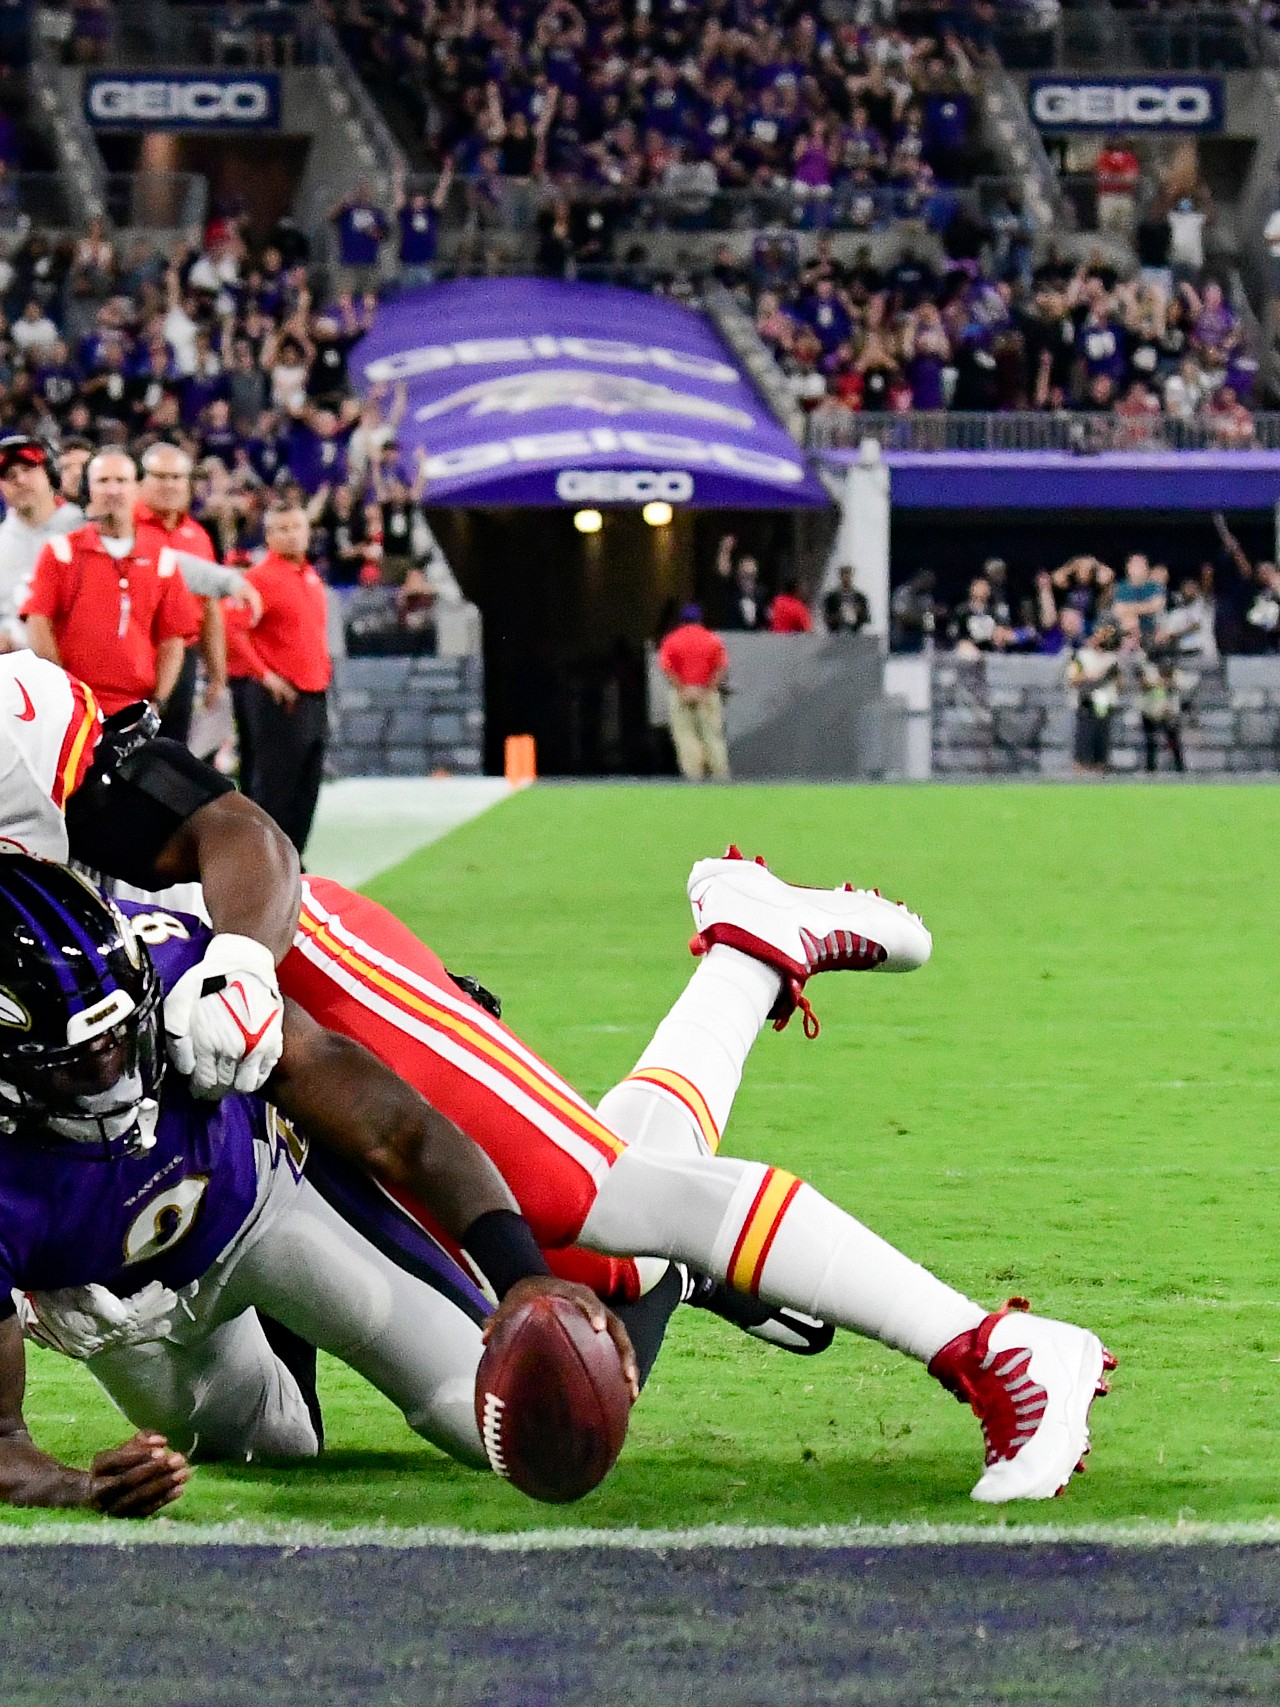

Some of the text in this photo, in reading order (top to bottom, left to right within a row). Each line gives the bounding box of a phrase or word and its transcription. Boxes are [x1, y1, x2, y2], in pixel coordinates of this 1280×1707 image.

[91, 82, 268, 120] GEICO
[1035, 85, 1211, 124] GEICO
[131, 909, 191, 946] 8
